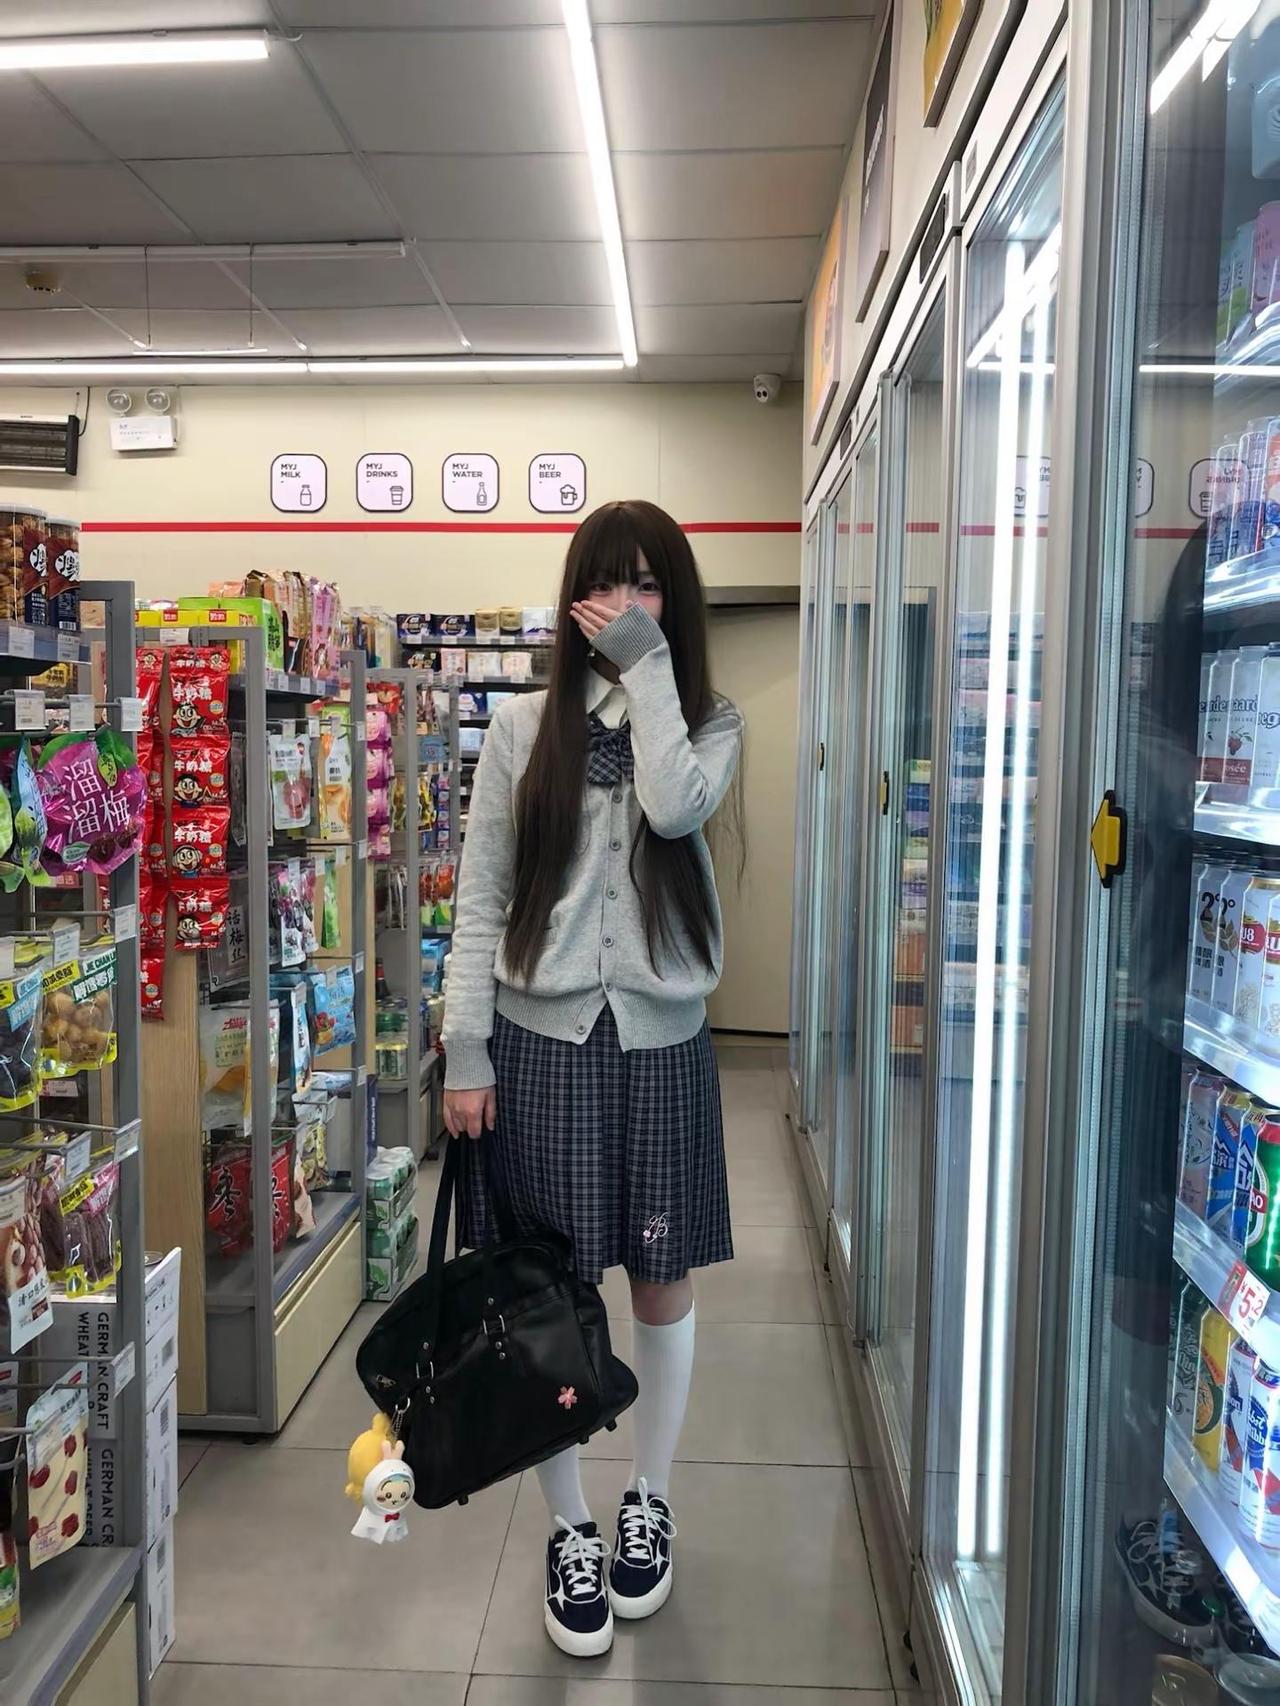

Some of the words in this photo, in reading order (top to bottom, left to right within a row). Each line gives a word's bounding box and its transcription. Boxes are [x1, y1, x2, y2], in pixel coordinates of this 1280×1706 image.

[281, 463, 297, 471] MYJ
[539, 463, 556, 471] MYJ
[61, 758, 102, 801] 溜
[61, 790, 131, 844] 溜梅
[78, 1312, 90, 1357] WHEAT
[97, 1382, 109, 1430] CRAFT
[101, 1448, 114, 1518] GERMAN
